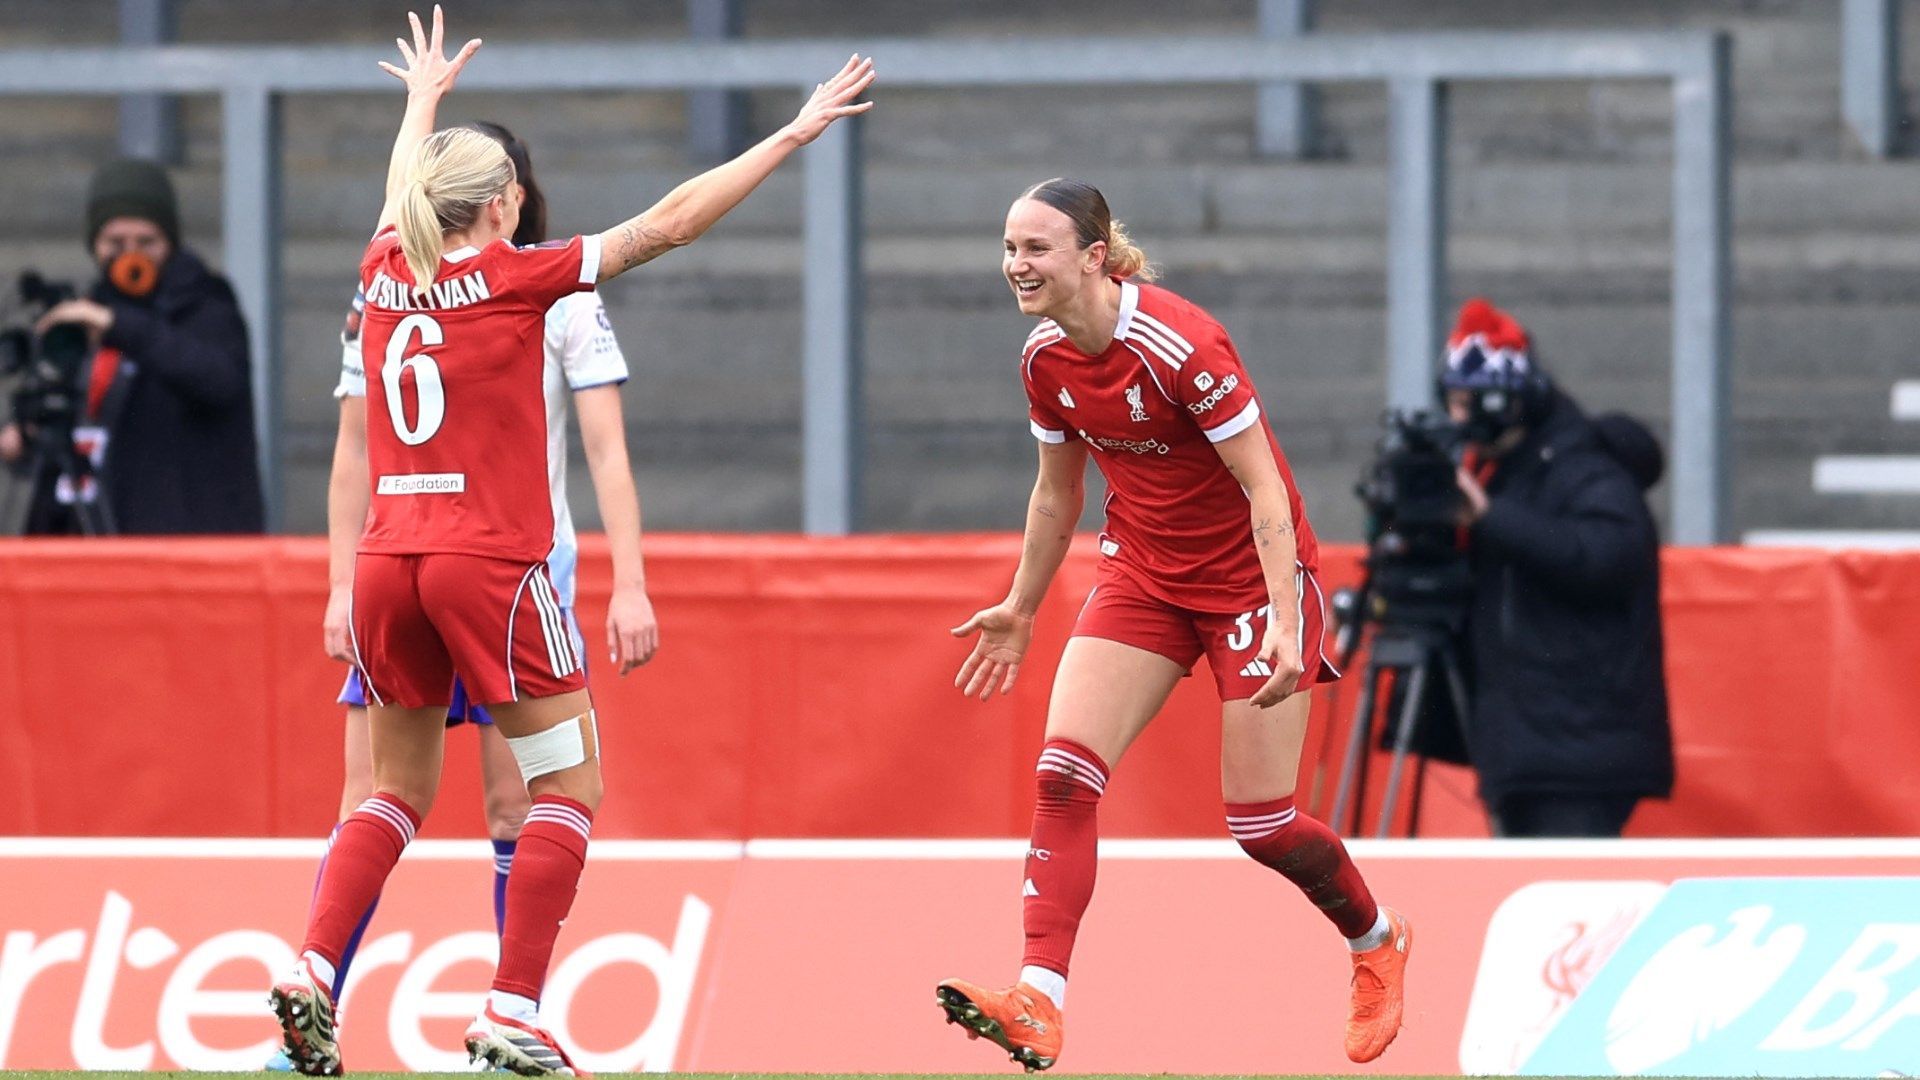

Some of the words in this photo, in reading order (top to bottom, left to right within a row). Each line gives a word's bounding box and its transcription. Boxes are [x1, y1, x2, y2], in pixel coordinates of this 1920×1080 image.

[381, 313, 446, 446] 6
[1186, 373, 1239, 415] Expedia
[394, 477, 459, 491] Foundation
